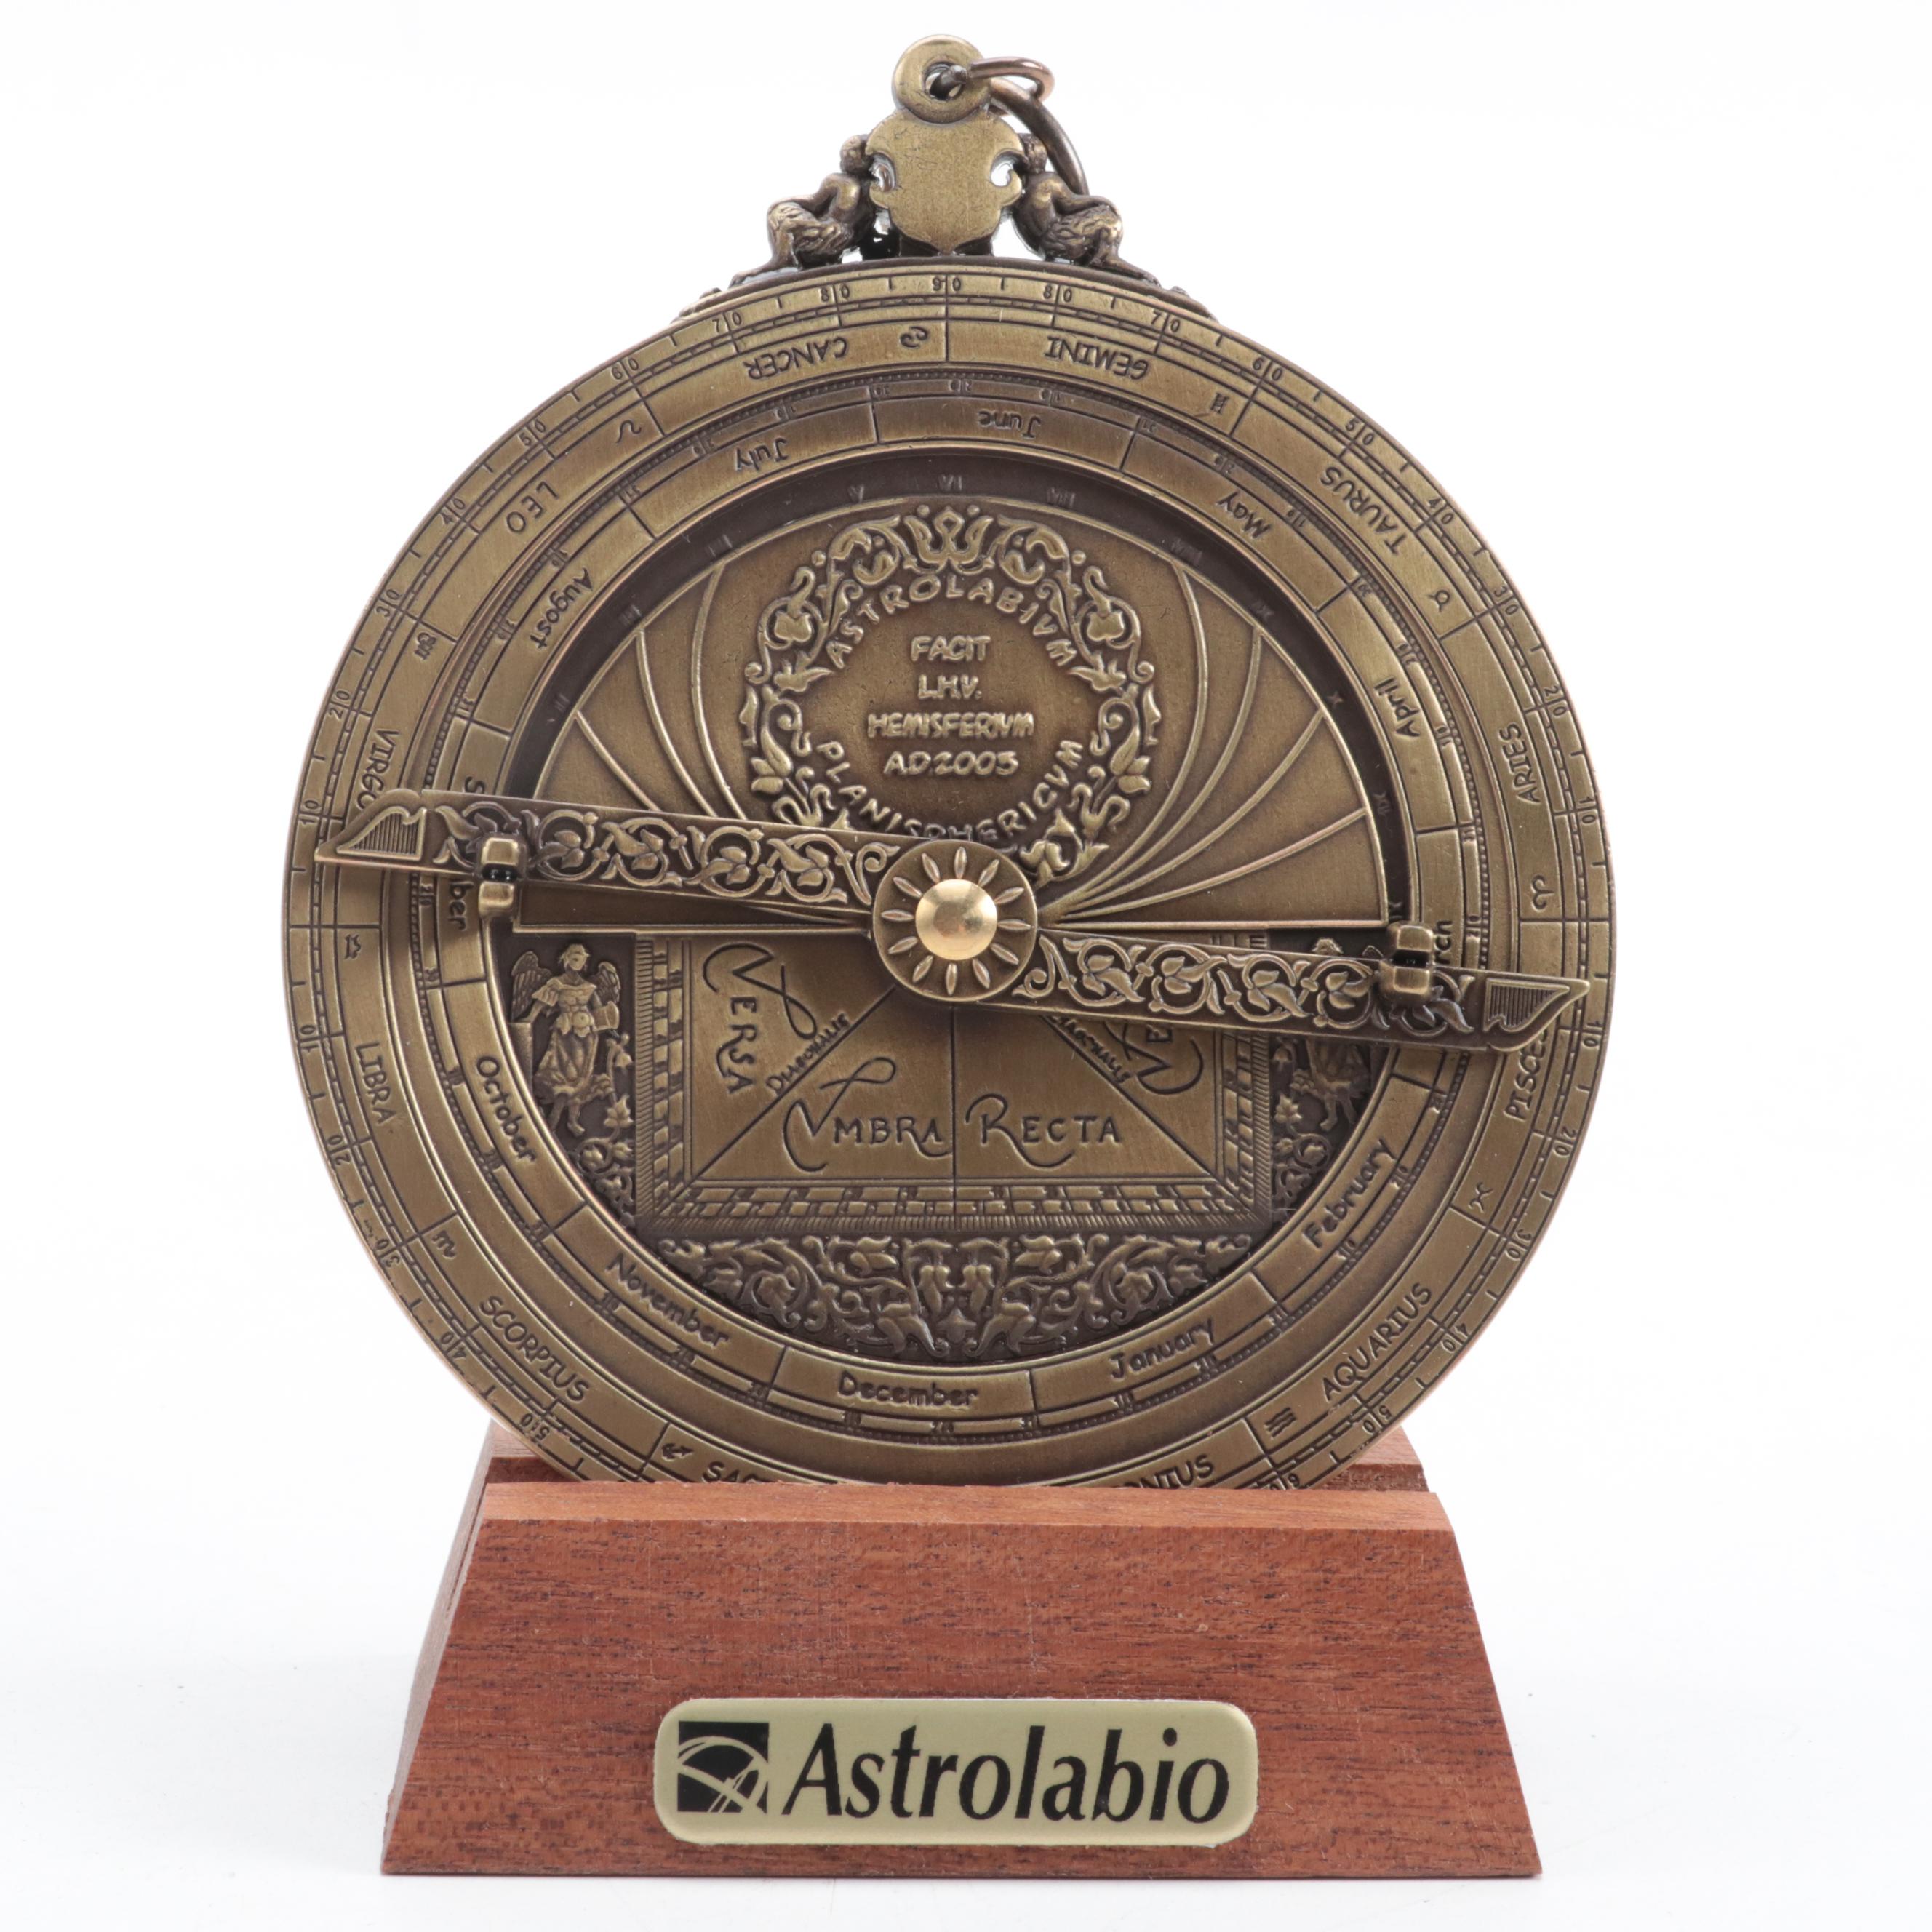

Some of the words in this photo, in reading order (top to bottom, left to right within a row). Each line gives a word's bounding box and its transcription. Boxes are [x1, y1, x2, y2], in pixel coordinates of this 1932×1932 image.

[743, 336, 847, 380] CANCER
[1044, 337, 1149, 380] GEMINI
[735, 437, 789, 471] July
[978, 410, 1041, 438] June
[506, 481, 559, 533] LEO
[1216, 492, 1272, 540] May
[1320, 466, 1408, 555] TAURUS
[826, 574, 1077, 669] ASTROLABIVM
[911, 636, 991, 660] FACIT
[1374, 677, 1419, 737] April
[1500, 724, 1541, 802] ARIES
[356, 1042, 396, 1124] LIBRA
[477, 1056, 536, 1162] October
[965, 1093, 1122, 1169] RECTA
[1304, 1139, 1396, 1248] February
[606, 1253, 729, 1346] November
[479, 1296, 588, 1401] SCORPIUS
[1110, 1318, 1214, 1379] January
[1322, 1282, 1432, 1402] AQUARIUS
[838, 1370, 978, 1408] December
[783, 1723, 1229, 1824] Astrolabio
